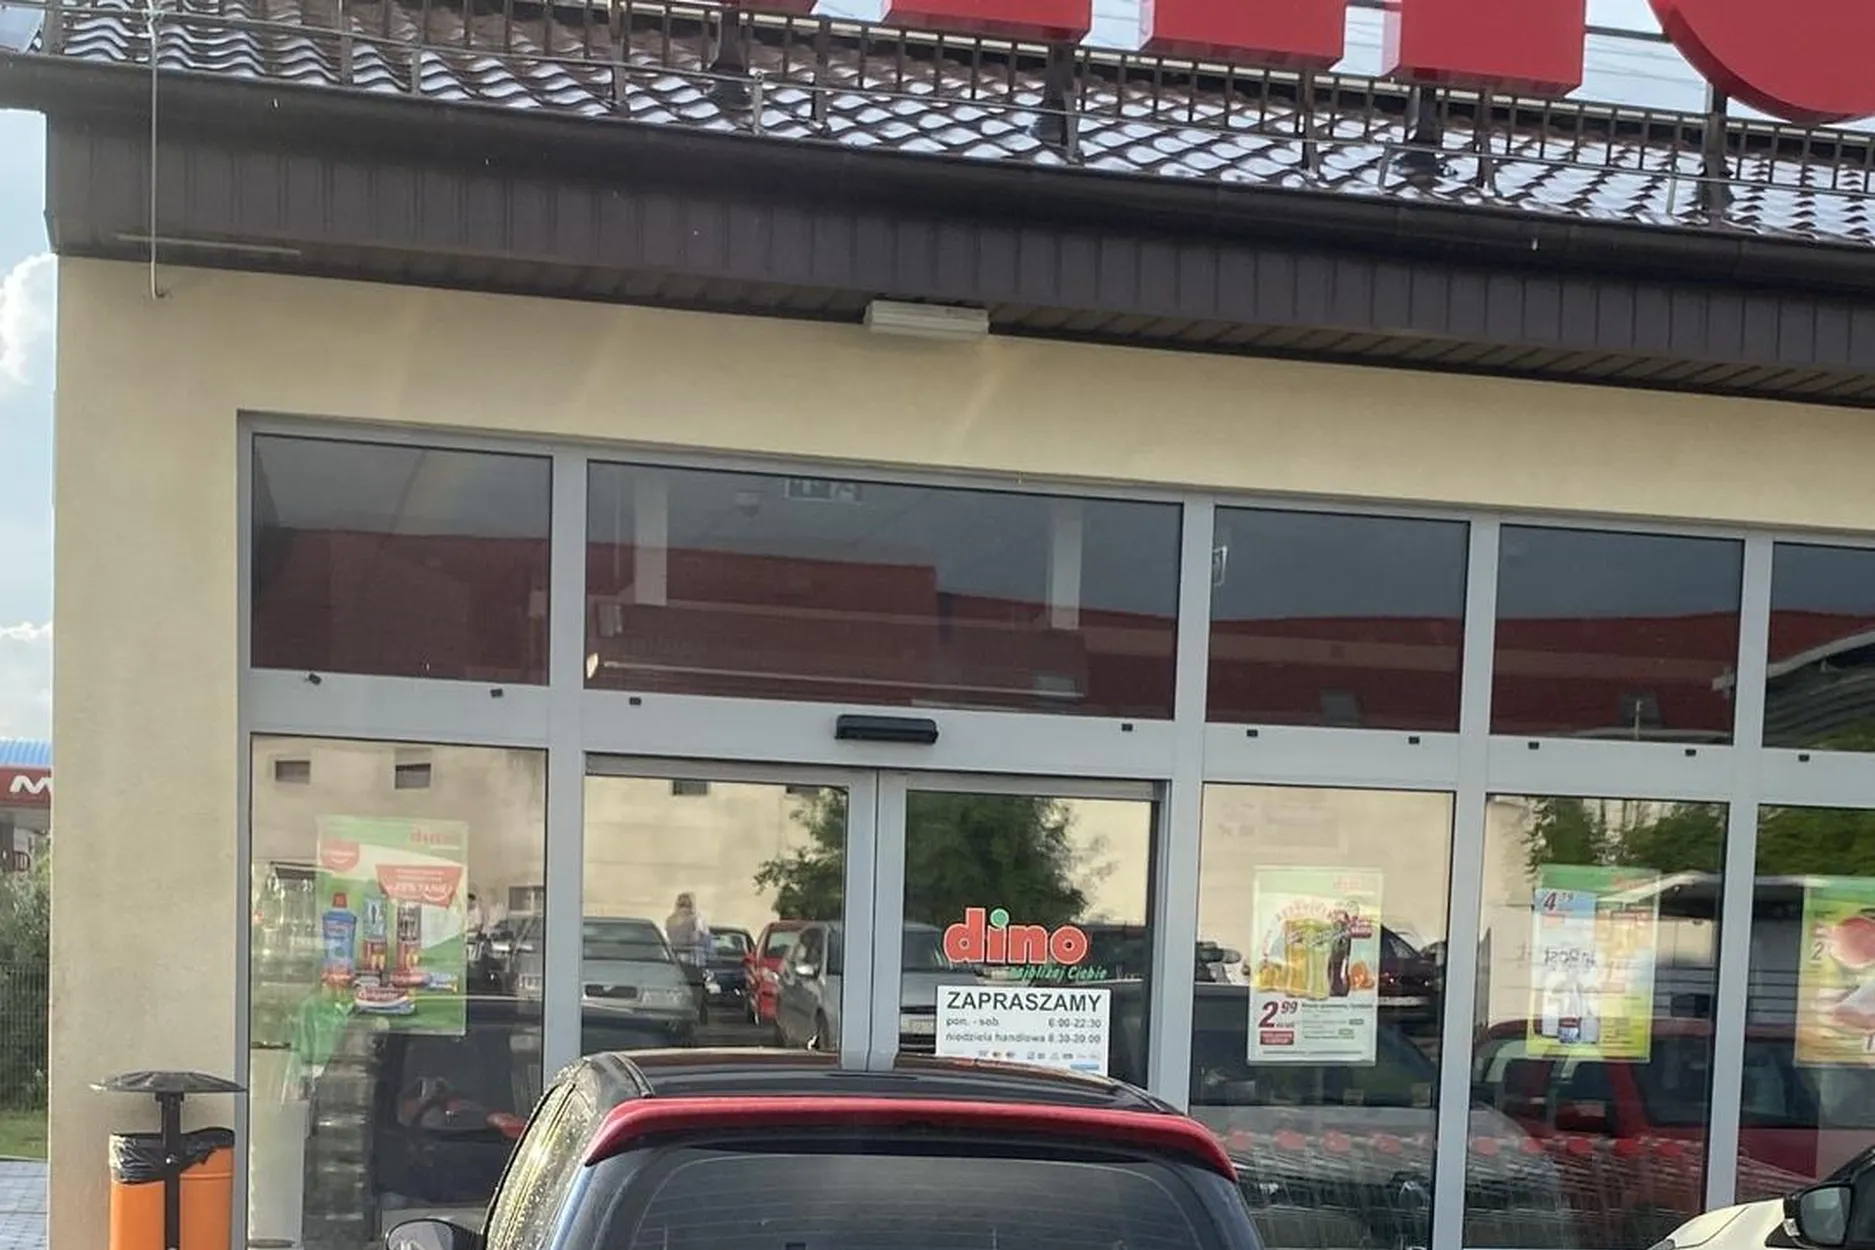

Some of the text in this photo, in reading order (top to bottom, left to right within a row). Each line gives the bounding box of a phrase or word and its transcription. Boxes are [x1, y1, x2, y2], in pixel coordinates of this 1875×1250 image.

[943, 907, 1088, 965] dino
[946, 991, 1102, 1012] ZAPRASZAMY
[945, 1030, 992, 1043] niedziela
